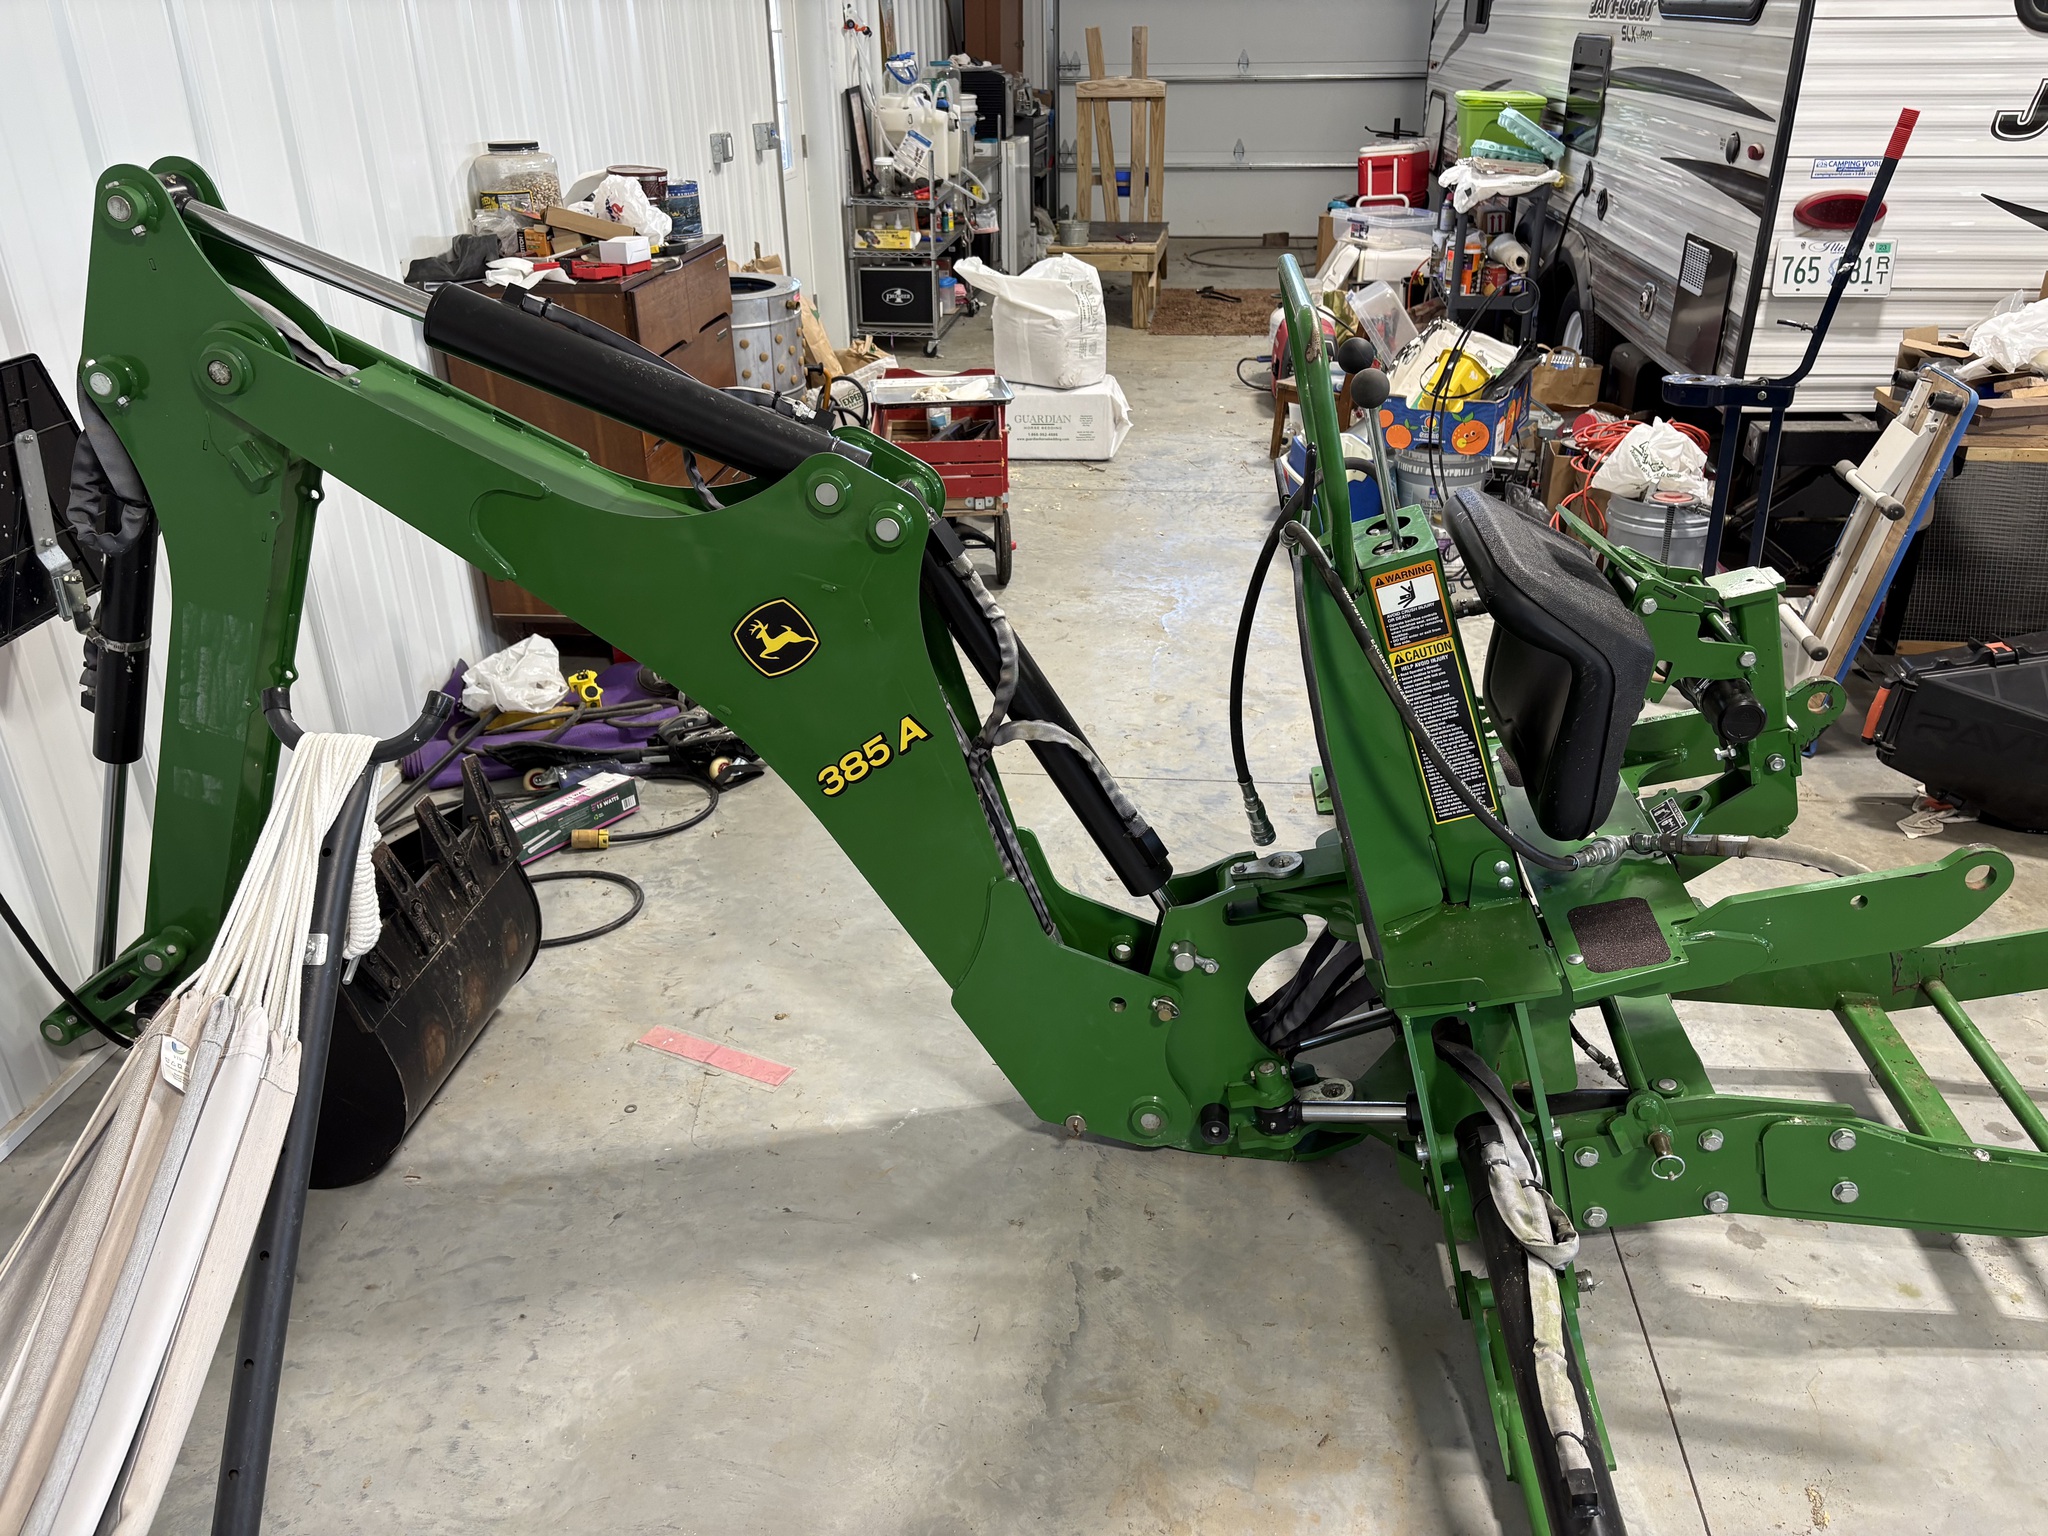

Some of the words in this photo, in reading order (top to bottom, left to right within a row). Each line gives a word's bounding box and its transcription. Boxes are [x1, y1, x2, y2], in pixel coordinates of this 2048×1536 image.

[1621, 25, 1637, 43] SLX
[1782, 256, 1821, 284] 765
[1841, 256, 1873, 284] 81
[842, 392, 862, 406] EXPER
[1014, 414, 1072, 424] GUARDIAN
[1384, 563, 1433, 583] WARNING
[1405, 640, 1452, 661] CAUTION
[1430, 655, 1448, 663] INJURY
[816, 732, 894, 797] 385
[898, 714, 933, 755] A
